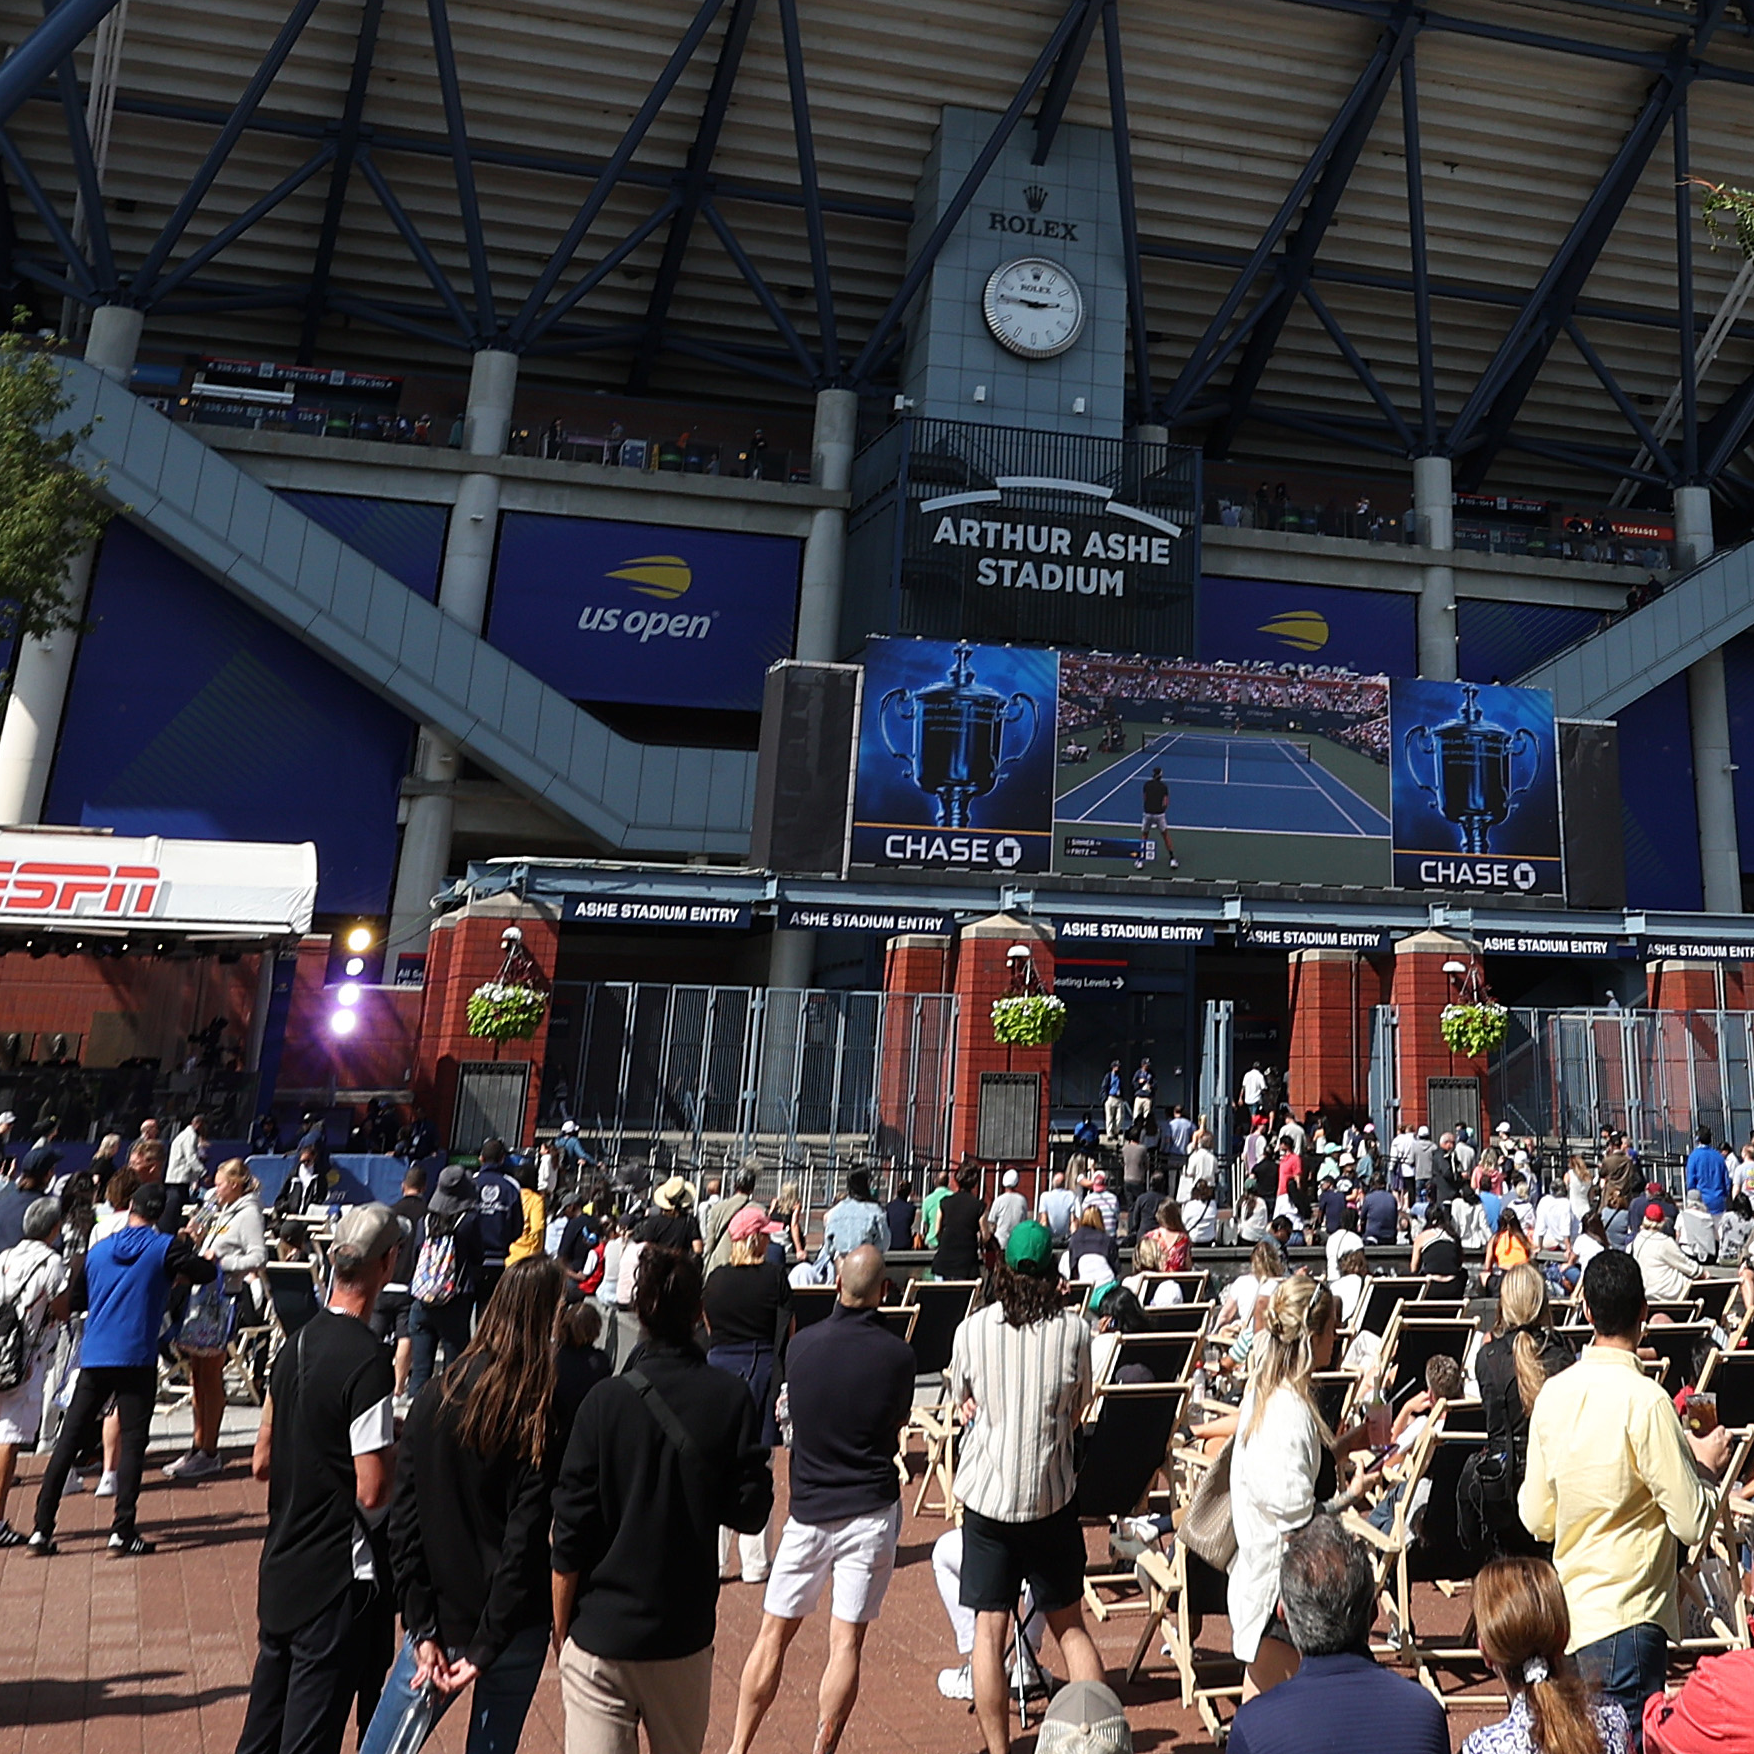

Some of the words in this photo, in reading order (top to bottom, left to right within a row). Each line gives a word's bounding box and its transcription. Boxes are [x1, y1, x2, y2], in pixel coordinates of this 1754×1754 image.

[989, 212, 1078, 241] ROLEX
[1020, 283, 1052, 294] ROLEX
[933, 516, 1072, 556] ARTHUR
[1082, 531, 1171, 565] ASHE
[1619, 526, 1658, 536] SAUSAGES
[976, 557, 1124, 597] STADIUM
[578, 606, 622, 631] us
[623, 610, 712, 642] open
[885, 834, 991, 863] CHASE
[1420, 860, 1510, 886] CHASE
[575, 902, 618, 919] ASHE
[621, 904, 686, 921] STADIUM
[690, 906, 740, 923] ENTRY
[789, 911, 829, 927] ASHE
[832, 913, 894, 929] STADIUM
[897, 916, 944, 932] ENTRY
[1061, 922, 1098, 937] ASHE
[1102, 924, 1159, 939] STADIUM
[1162, 926, 1204, 941] ENTRY
[1246, 929, 1280, 944] ASHE
[1283, 930, 1338, 945] STADIUM
[1340, 933, 1380, 947] ENTRY
[1484, 937, 1516, 951] ASHE
[1518, 938, 1568, 953] STADIUM
[1571, 940, 1608, 954] ENTRY
[1647, 943, 1677, 956] ASHE
[1679, 944, 1727, 958] STADIUM
